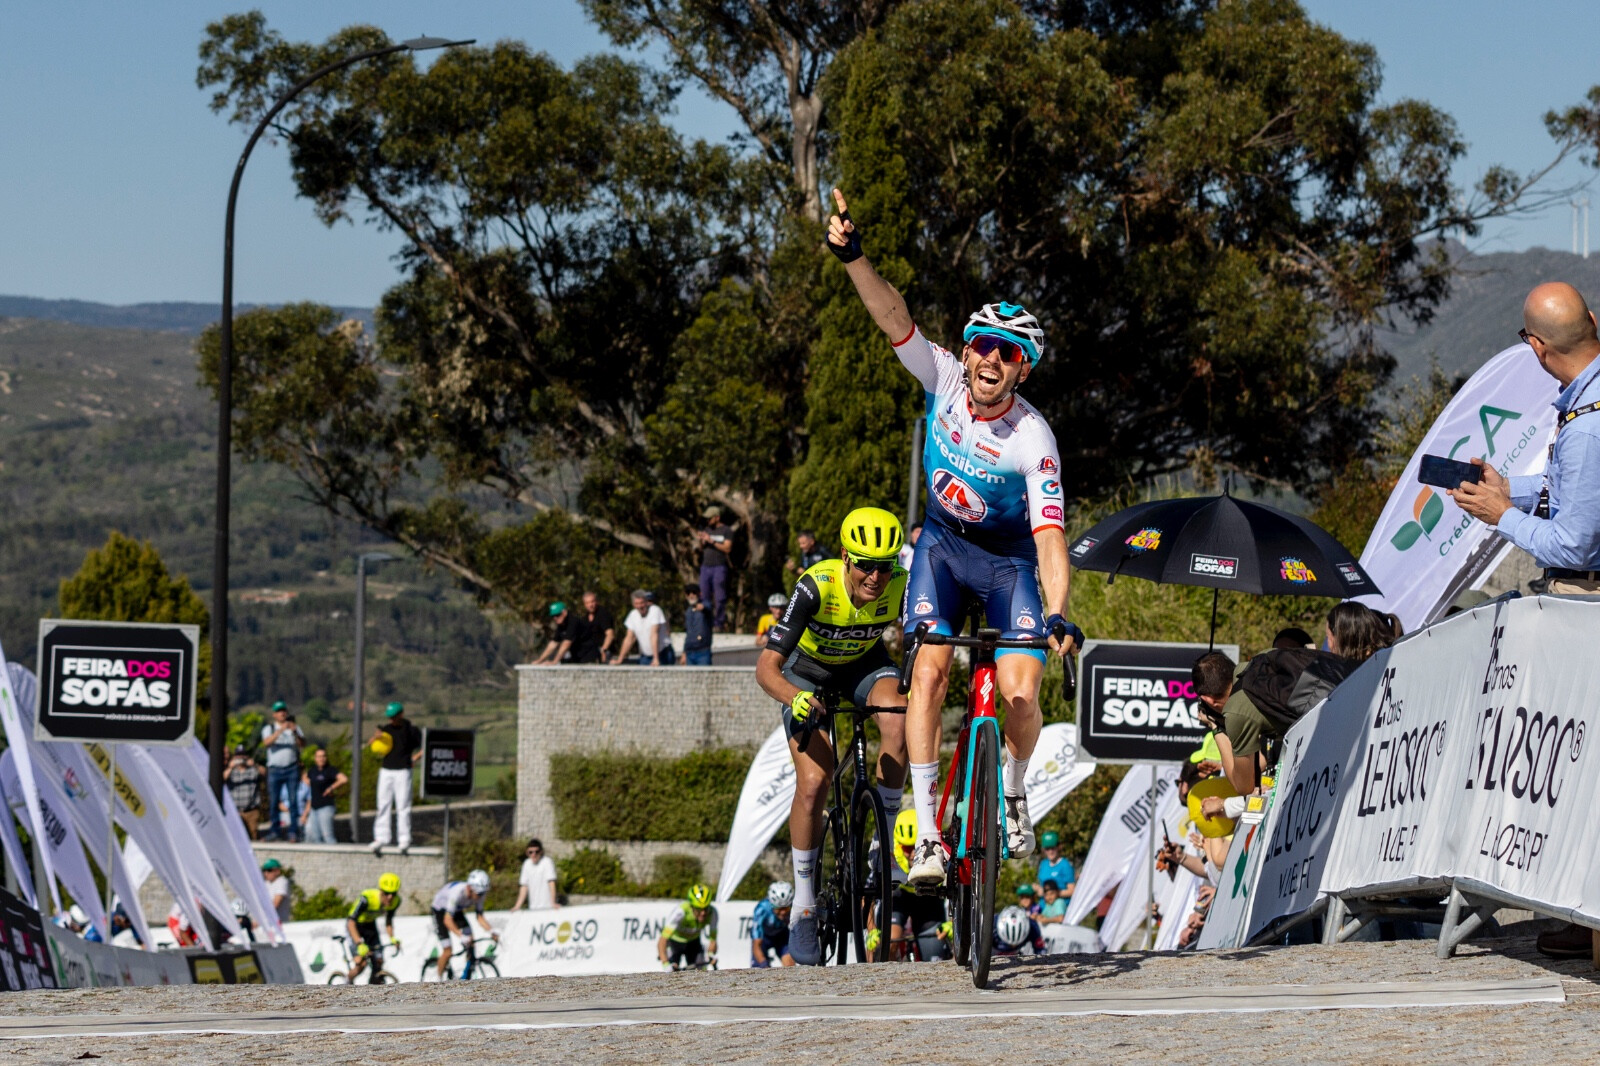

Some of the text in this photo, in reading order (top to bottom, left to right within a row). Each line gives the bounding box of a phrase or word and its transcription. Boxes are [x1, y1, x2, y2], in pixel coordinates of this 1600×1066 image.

[932, 420, 1006, 485] Credibom
[1500, 425, 1537, 479] grícola
[1280, 568, 1317, 582] FESTA
[808, 621, 886, 640] anicolo
[60, 676, 171, 708] SOFÁS
